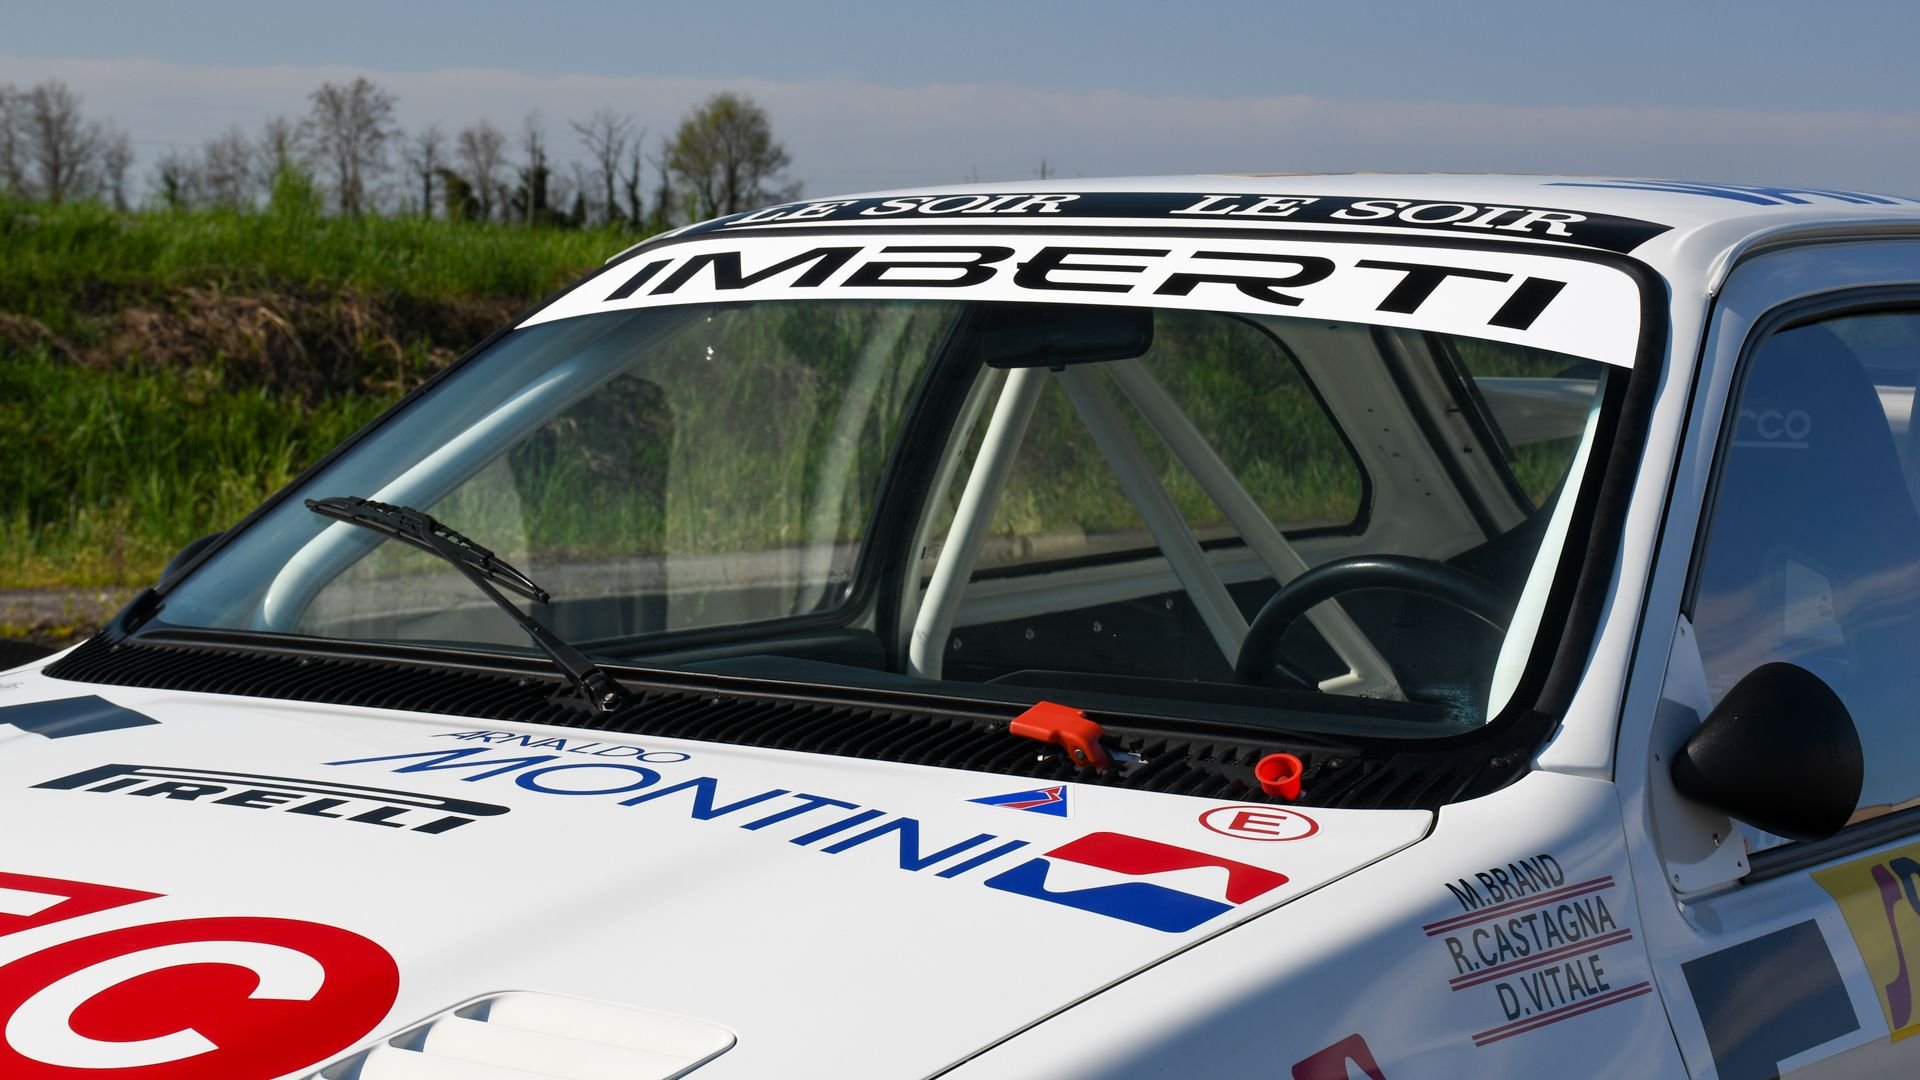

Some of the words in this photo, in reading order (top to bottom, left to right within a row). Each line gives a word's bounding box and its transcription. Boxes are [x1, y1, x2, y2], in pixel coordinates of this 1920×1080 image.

[859, 194, 1081, 215] SOIR
[1169, 194, 1321, 217] LE
[1330, 199, 1587, 237] SOIR
[602, 246, 1568, 331] IMBERTI
[431, 730, 691, 763] ARNALDO
[28, 764, 511, 834] PIRELLI
[321, 747, 1032, 879] MONTINI
[1228, 811, 1288, 836] E
[1445, 854, 1565, 911] M.BRAND
[1445, 895, 1617, 974] R.CASTAGNA
[1495, 954, 1610, 1021] D.VITALE
